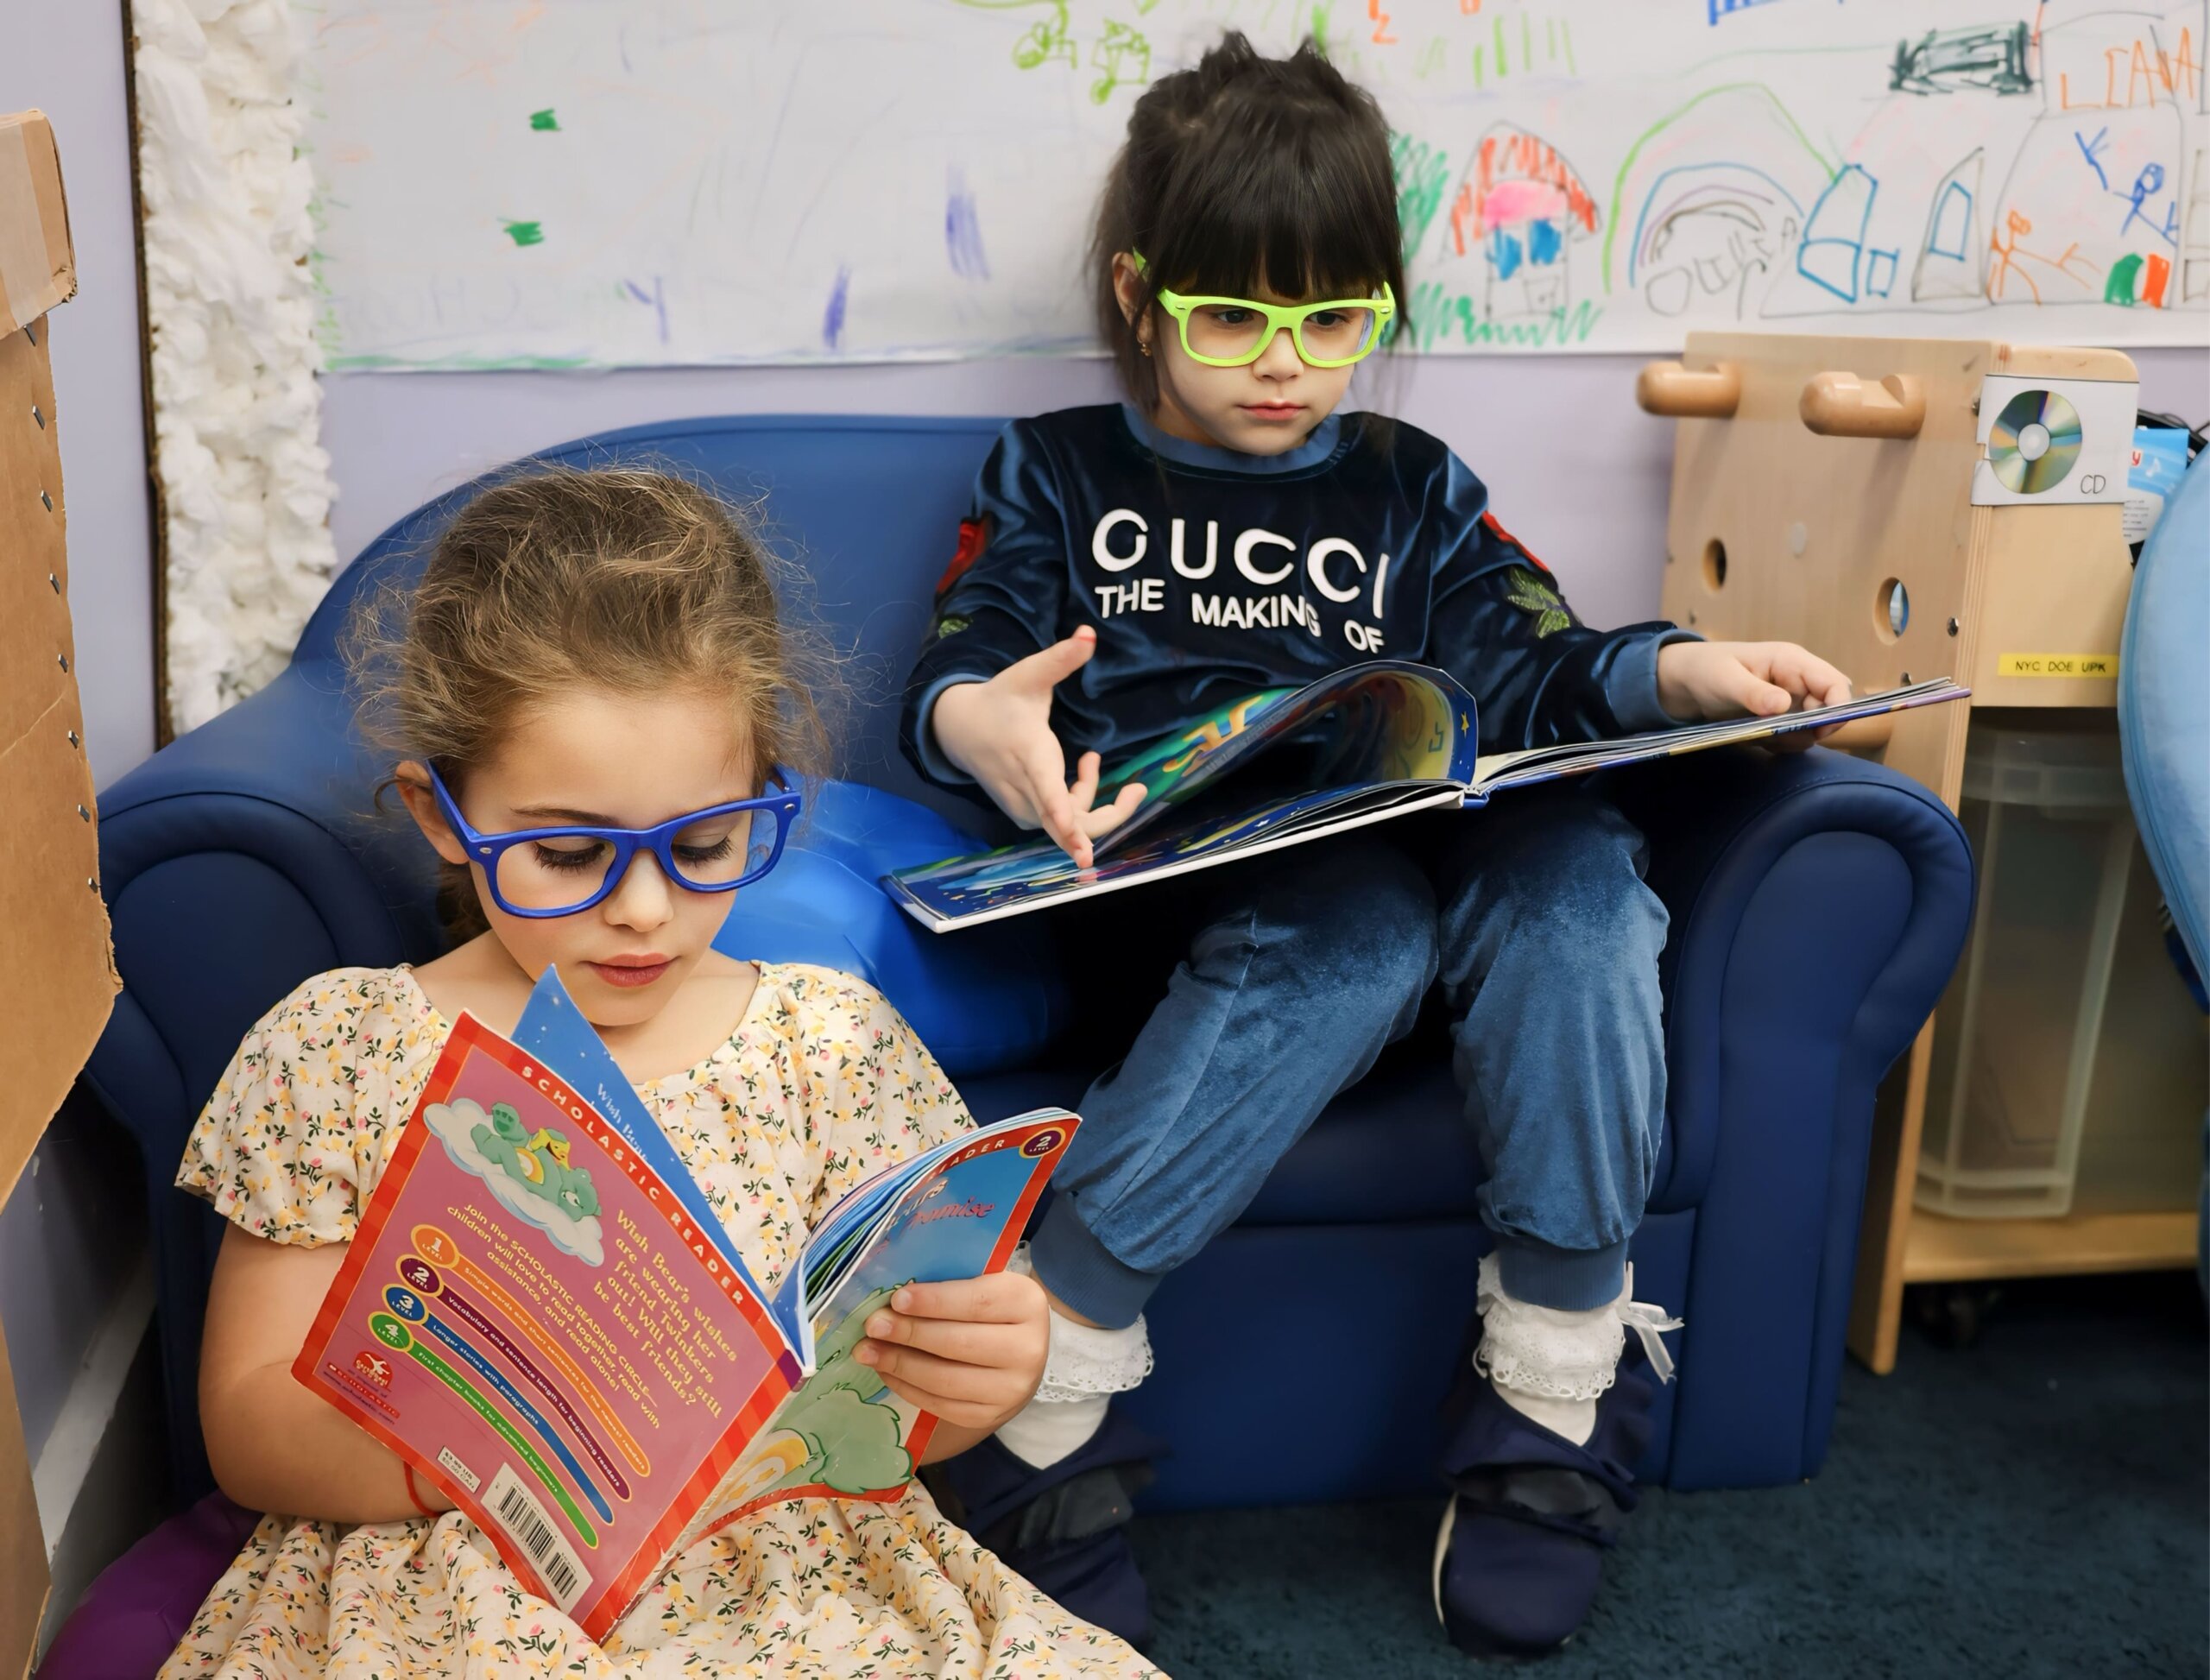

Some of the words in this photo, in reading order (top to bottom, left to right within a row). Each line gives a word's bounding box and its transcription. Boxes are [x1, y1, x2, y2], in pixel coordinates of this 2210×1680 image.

[2080, 474, 2106, 496] CD
[1091, 508, 1391, 620] GUCCI
[1094, 578, 1166, 619] THE
[1190, 591, 1323, 638] MAKING
[1343, 619, 1386, 654] OF
[2015, 660, 2041, 673] NYC
[2047, 660, 2073, 673] DOE
[2081, 660, 2106, 673] UPK
[597, 1083, 622, 1124] Wish
[1036, 1136, 1051, 1147] 2
[521, 1065, 660, 1200] SCHOLASTIC
[670, 1212, 743, 1304] READER
[407, 1273, 428, 1290] LEVEL
[413, 1266, 430, 1283] 2
[421, 1243, 443, 1261] LEVEL
[431, 1237, 443, 1252] 1
[464, 1204, 488, 1225] Join
[489, 1222, 508, 1242] the
[510, 1241, 573, 1304] SCHOLASTIC
[574, 1304, 616, 1355] READING
[616, 1209, 649, 1254] Wish
[653, 1252, 690, 1304] Bear's
[693, 1306, 737, 1361] wishes
[377, 1328, 398, 1344] LEVEL
[385, 1323, 400, 1339] 4
[391, 1300, 414, 1318] LEVEL
[399, 1294, 414, 1310] 3
[447, 1206, 492, 1243] children
[495, 1241, 513, 1262] will
[515, 1258, 537, 1284] love
[539, 1282, 549, 1296] to
[551, 1295, 575, 1323] read
[576, 1321, 616, 1373] together,
[618, 1372, 640, 1401] read
[641, 1401, 660, 1429] with
[487, 1251, 542, 1304] assistance,
[544, 1305, 565, 1328] and
[565, 1327, 589, 1355] read
[590, 1355, 620, 1392] alone!
[594, 1281, 609, 1303] be
[613, 1303, 639, 1339] best
[641, 1341, 697, 1405] friends?
[607, 1277, 636, 1307] out!
[638, 1308, 665, 1344] Will
[666, 1346, 693, 1385] they
[696, 1386, 722, 1418] still
[615, 1260, 657, 1311] friend
[660, 1311, 713, 1384] Twinkers
[616, 1238, 637, 1264] are
[642, 1266, 691, 1332] wearing
[692, 1330, 716, 1360] her
[433, 1324, 458, 1348] Longer
[458, 1344, 483, 1369] stories
[484, 1367, 500, 1386] with
[499, 1384, 540, 1425] paragraphs
[447, 1297, 489, 1334] Vocabulary
[489, 1332, 505, 1347] and
[505, 1343, 536, 1380] sentence
[536, 1377, 559, 1403] length
[558, 1401, 569, 1415] for
[567, 1415, 597, 1456] beginning
[597, 1456, 620, 1487] readers
[464, 1267, 489, 1290] Simple
[491, 1289, 513, 1311] words
[514, 1311, 527, 1327] and
[528, 1326, 546, 1346] short
[580, 1380, 590, 1393] for
[590, 1393, 600, 1408] the
[622, 1439, 645, 1470] readers
[418, 1351, 434, 1366] First
[435, 1365, 464, 1390] chapter
[464, 1388, 485, 1412] books
[485, 1409, 496, 1421] for
[496, 1420, 529, 1456] advanced
[528, 1455, 559, 1493] beginners
